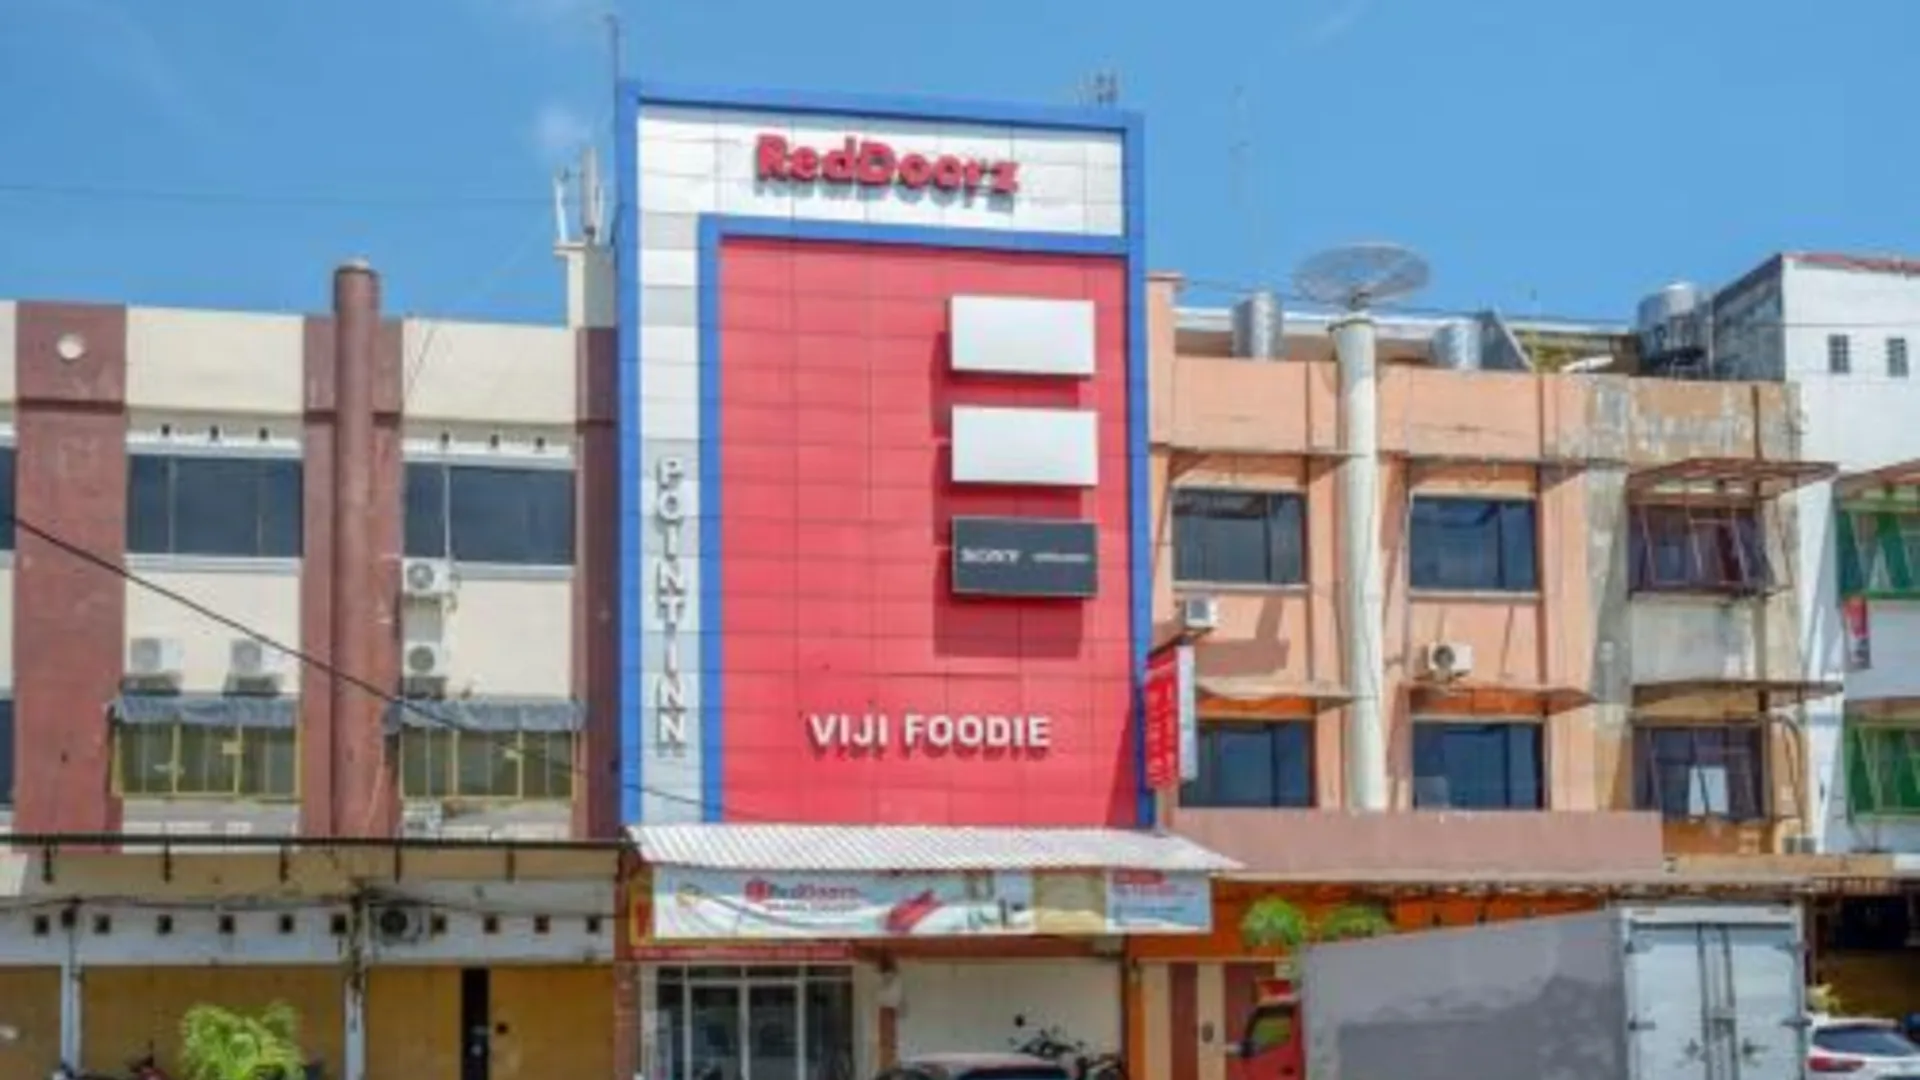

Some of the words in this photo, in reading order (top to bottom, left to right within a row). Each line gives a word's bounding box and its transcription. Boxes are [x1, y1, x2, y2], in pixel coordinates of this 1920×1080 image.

[756, 135, 1019, 194] RedDoorz
[656, 456, 684, 625] POINT
[960, 549, 1020, 564] SONY
[810, 714, 888, 746] VIJI
[905, 714, 1050, 748] FOODIE
